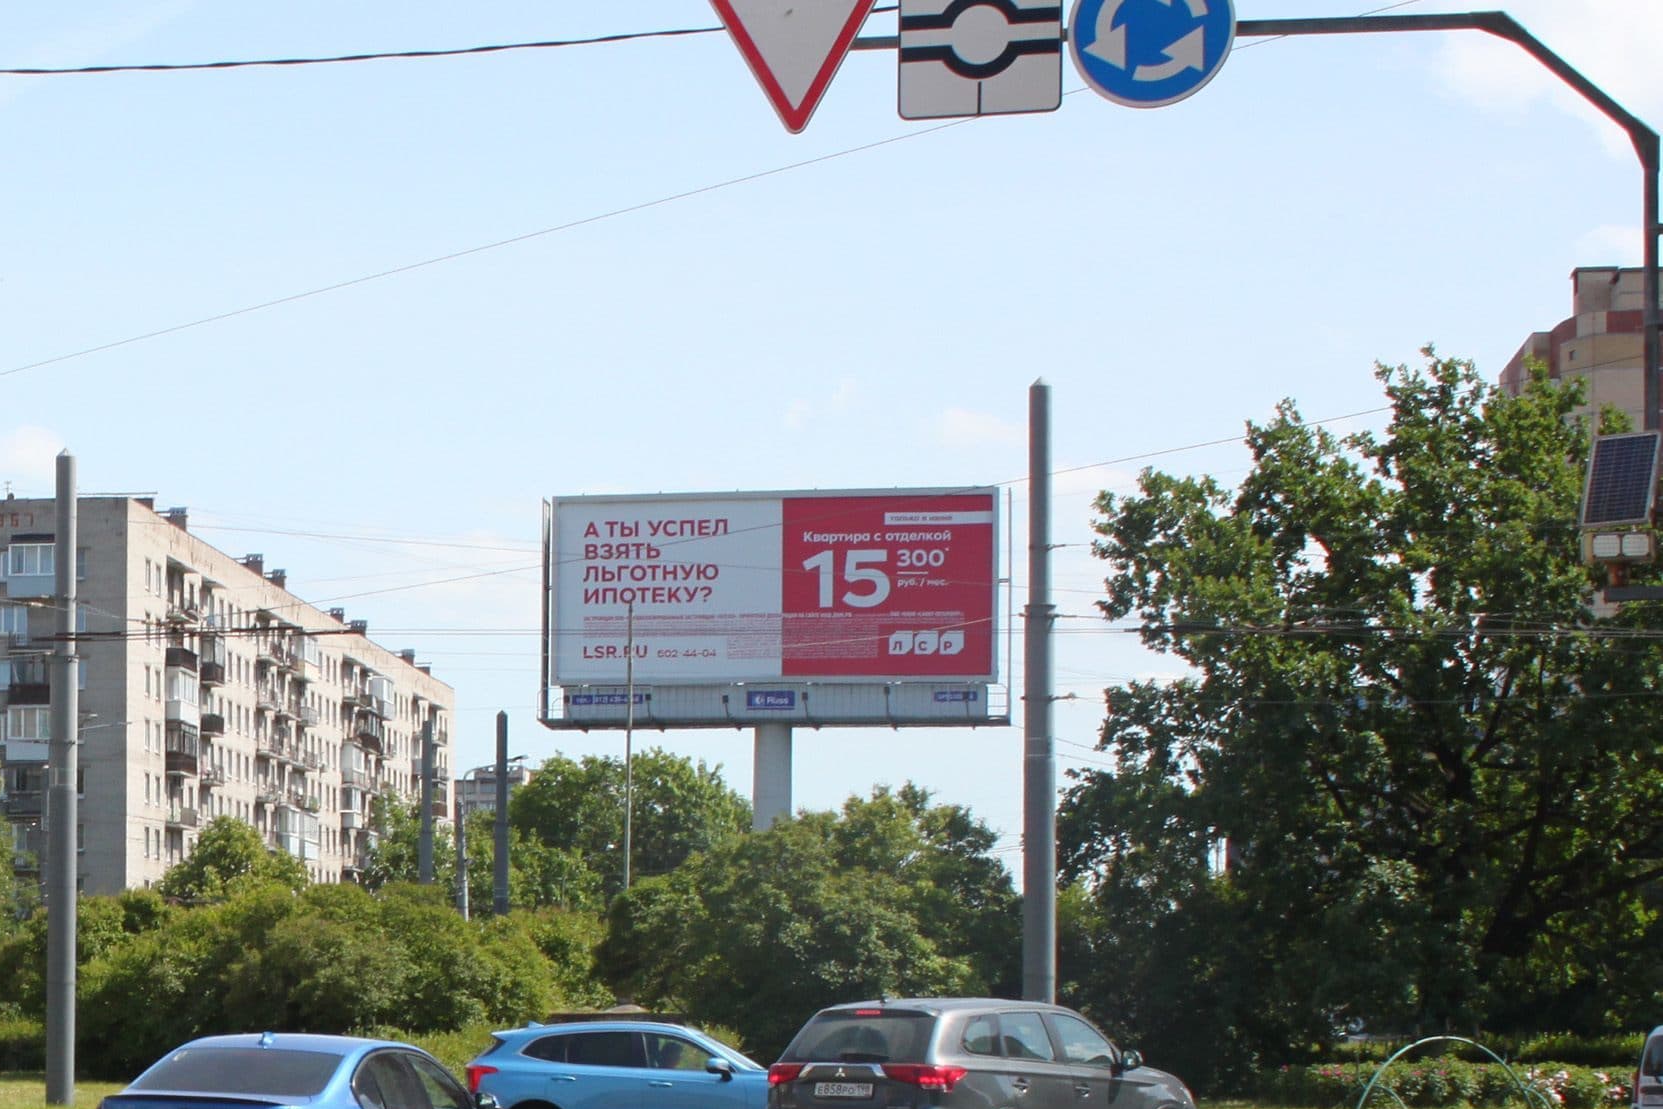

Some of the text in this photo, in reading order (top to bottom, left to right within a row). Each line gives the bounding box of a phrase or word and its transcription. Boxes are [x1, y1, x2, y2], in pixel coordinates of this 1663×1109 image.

[584, 518, 729, 538] А ТЫ УСПЕЛ
[802, 529, 952, 544] Квартира с отделкой
[584, 542, 661, 560] ВЗЯТЬ
[583, 563, 720, 582] ЛЬГОТНУЮ
[802, 549, 891, 608] 15
[583, 586, 713, 604] ИПОТЕКУ?
